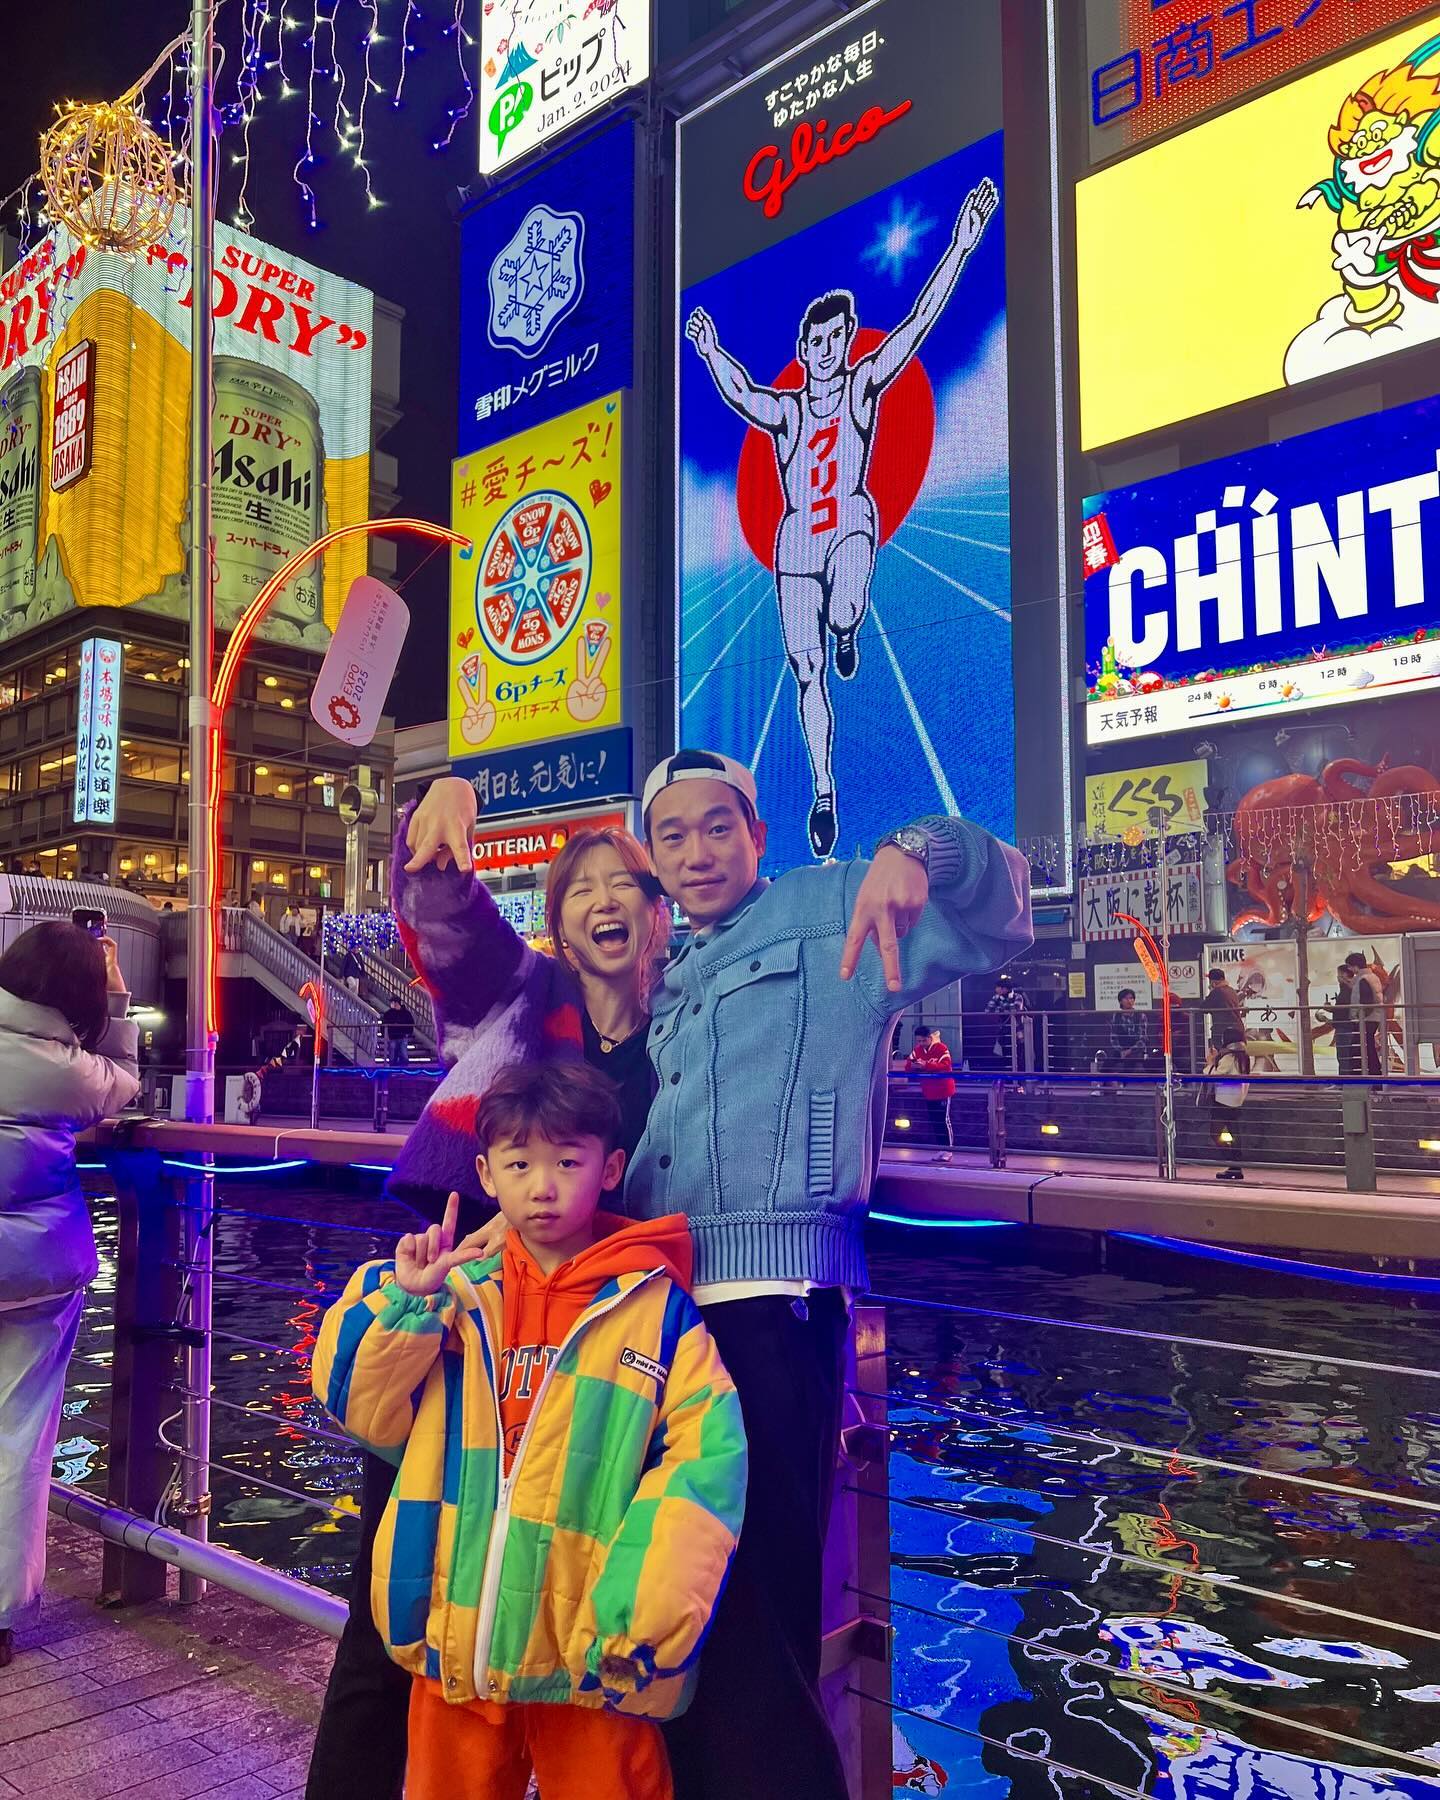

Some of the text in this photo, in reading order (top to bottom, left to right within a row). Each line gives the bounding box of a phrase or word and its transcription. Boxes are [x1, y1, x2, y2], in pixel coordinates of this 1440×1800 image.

[541, 28, 606, 101] ピップ
[765, 30, 886, 111] すこやかな毎日、
[537, 105, 571, 132] Jan.
[590, 59, 633, 98] 2024
[773, 59, 873, 128] ゆたかな人生
[743, 99, 913, 219] Glico
[222, 245, 316, 302] SUPER
[56, 351, 88, 402] ASAHI
[474, 342, 600, 421] 雪印メグミルク
[54, 398, 86, 447] 1889
[242, 407, 283, 427] SUPER
[53, 437, 83, 483] OSAKA
[212, 438, 311, 511] Asahi
[807, 416, 841, 535] グリコ
[3, 508, 16, 530] 生
[245, 500, 273, 525] 生
[519, 506, 546, 526] SNOW
[226, 532, 291, 559] スーパードライ
[560, 517, 580, 550] SNOW
[487, 538, 505, 578] SNOW
[295, 583, 317, 609] お酒
[559, 578, 579, 620] SNOW
[487, 604, 505, 637] SNOW
[517, 632, 546, 651] SNOW
[1320, 667, 1347, 680] 12時
[1393, 654, 1422, 667] 18時
[343, 663, 360, 696] EXPO
[352, 670, 369, 702] 2025
[1259, 679, 1278, 690] 6時
[1187, 691, 1212, 703] 24時
[1101, 705, 1158, 732] 天気予報
[472, 835, 546, 859] OTTERIA
